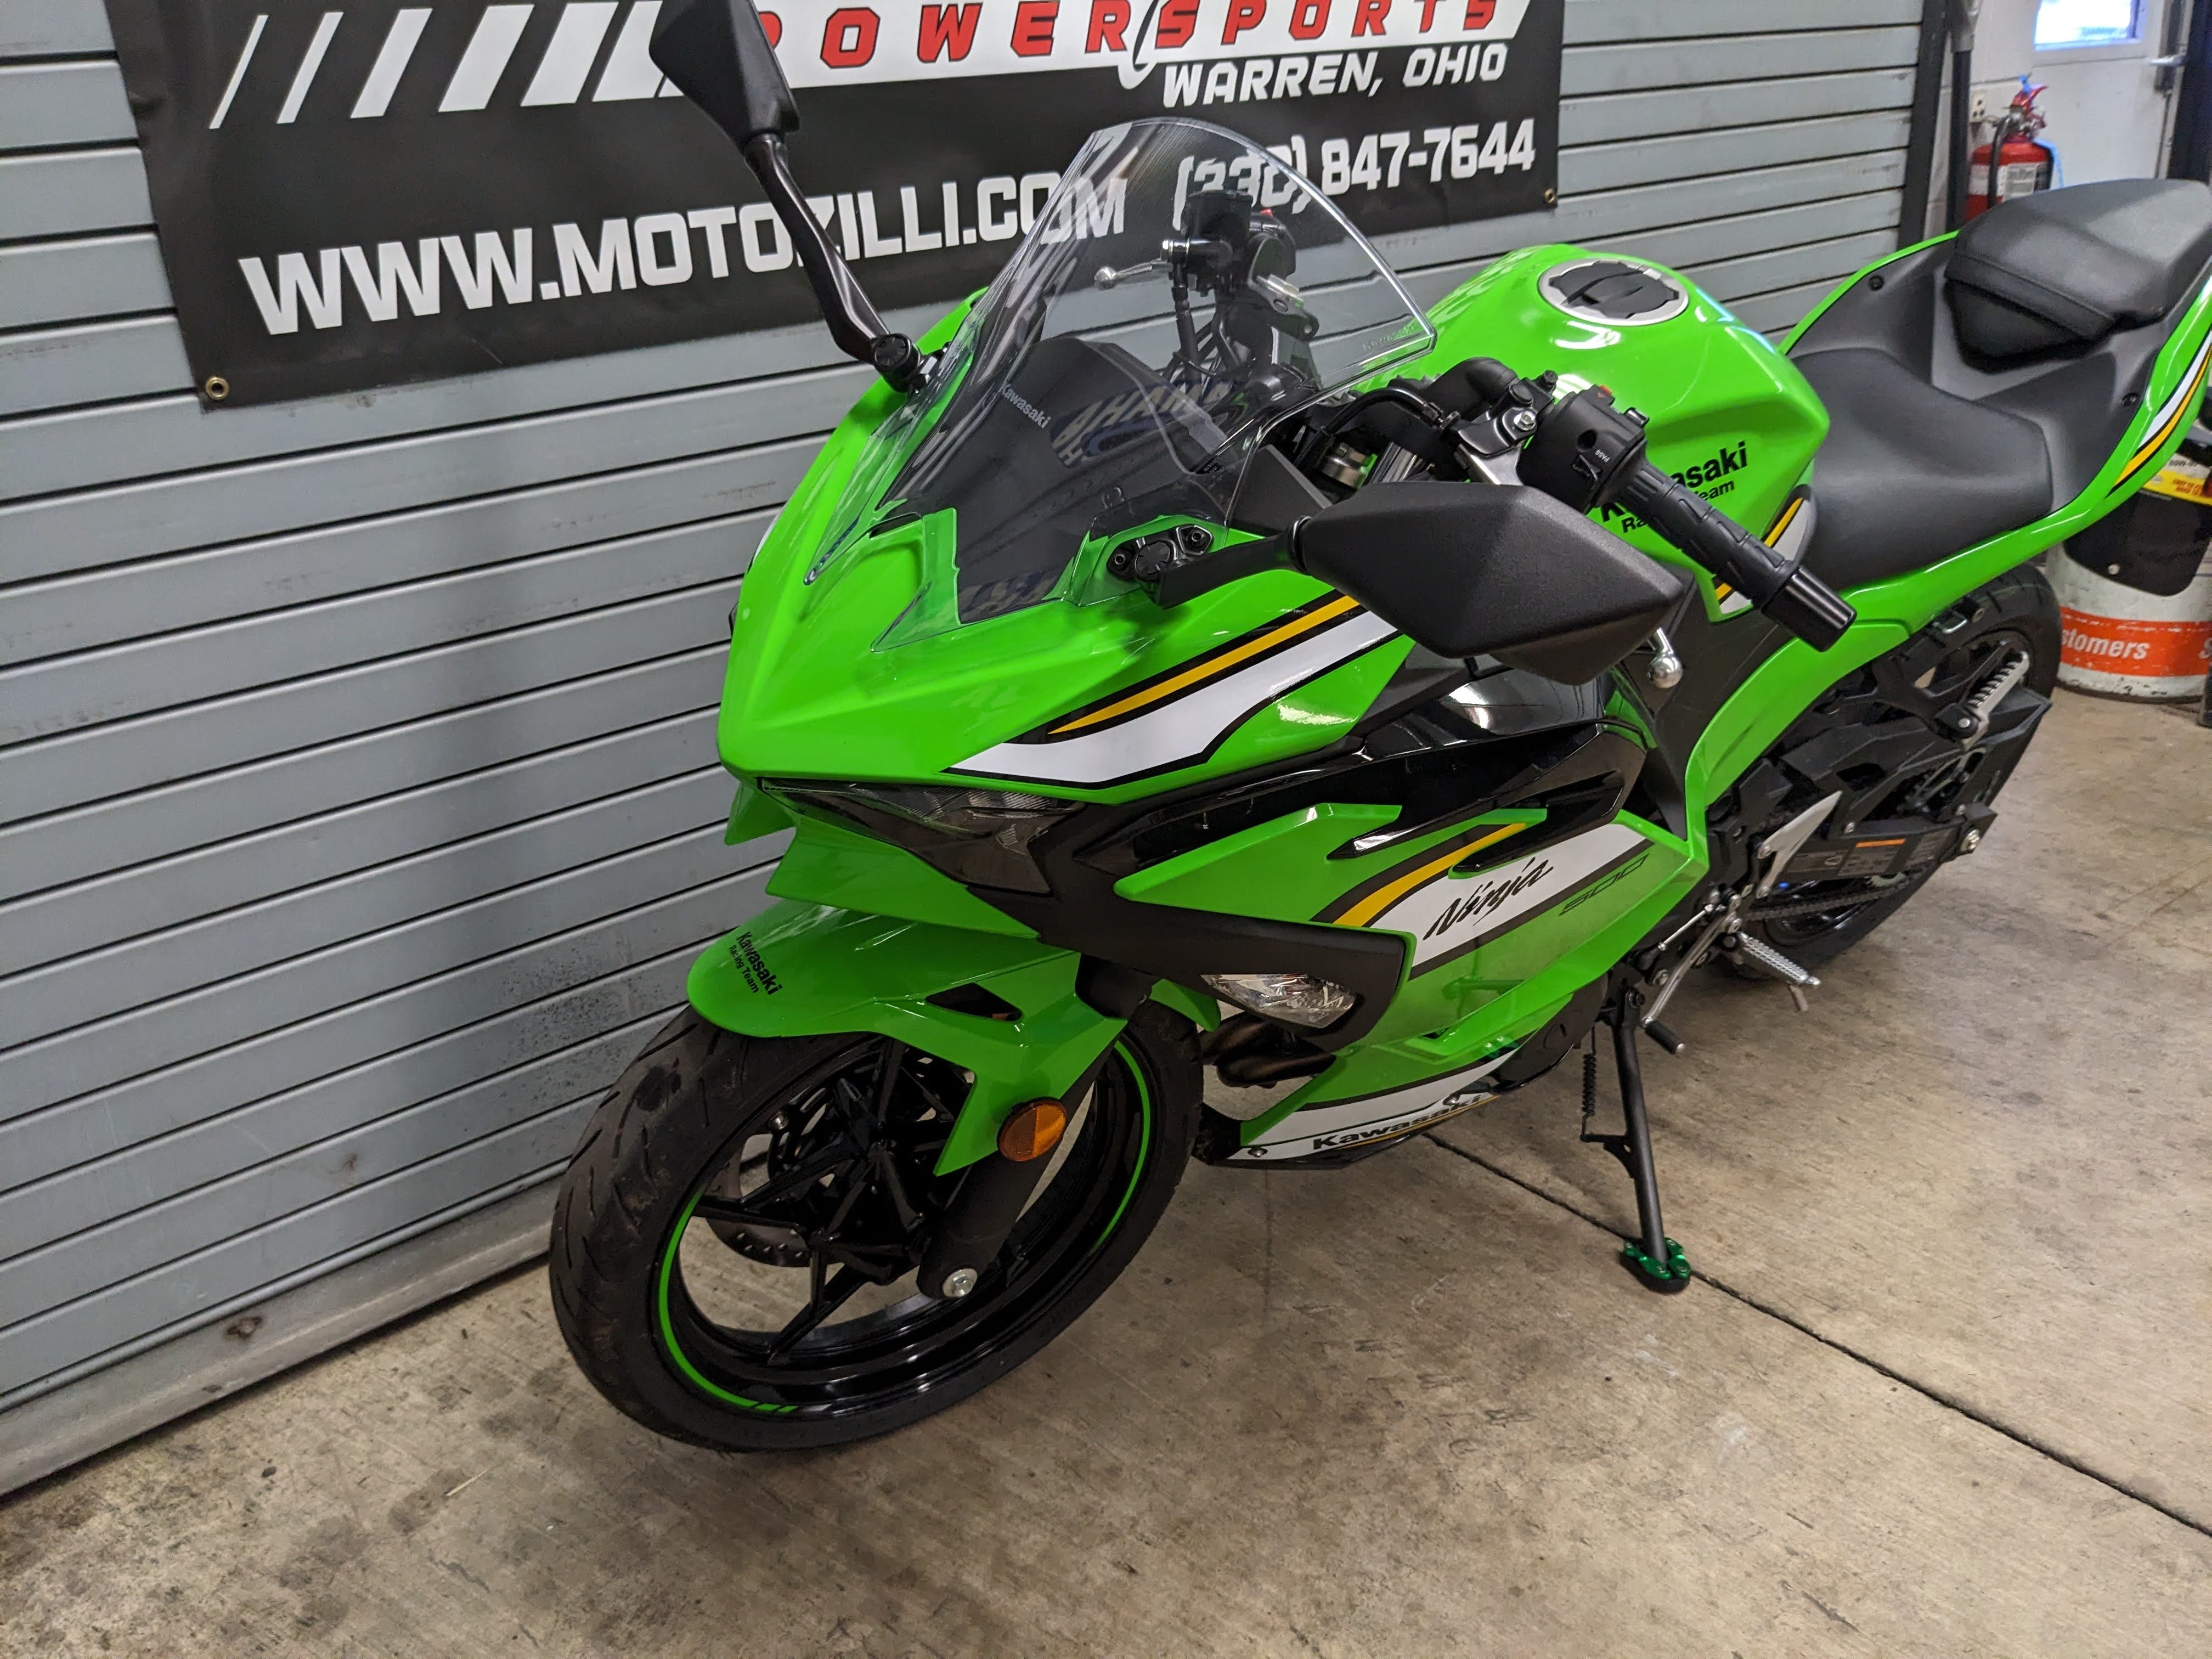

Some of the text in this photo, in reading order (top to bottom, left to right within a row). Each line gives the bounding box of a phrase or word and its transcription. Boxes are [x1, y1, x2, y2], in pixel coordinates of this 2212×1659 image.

[758, 0, 1494, 69] OWERSPORTS
[1163, 43, 1508, 108] WARREN, OHIO
[1321, 119, 1536, 196] 847-7644
[1002, 382, 1052, 428] Kawasaki
[1595, 449, 1611, 462] PASS
[1423, 857, 1554, 941] Ninja
[729, 945, 759, 993] Racing Team
[737, 932, 783, 995] Kawasaki
[1313, 1095, 1481, 1150] Kawasaki
